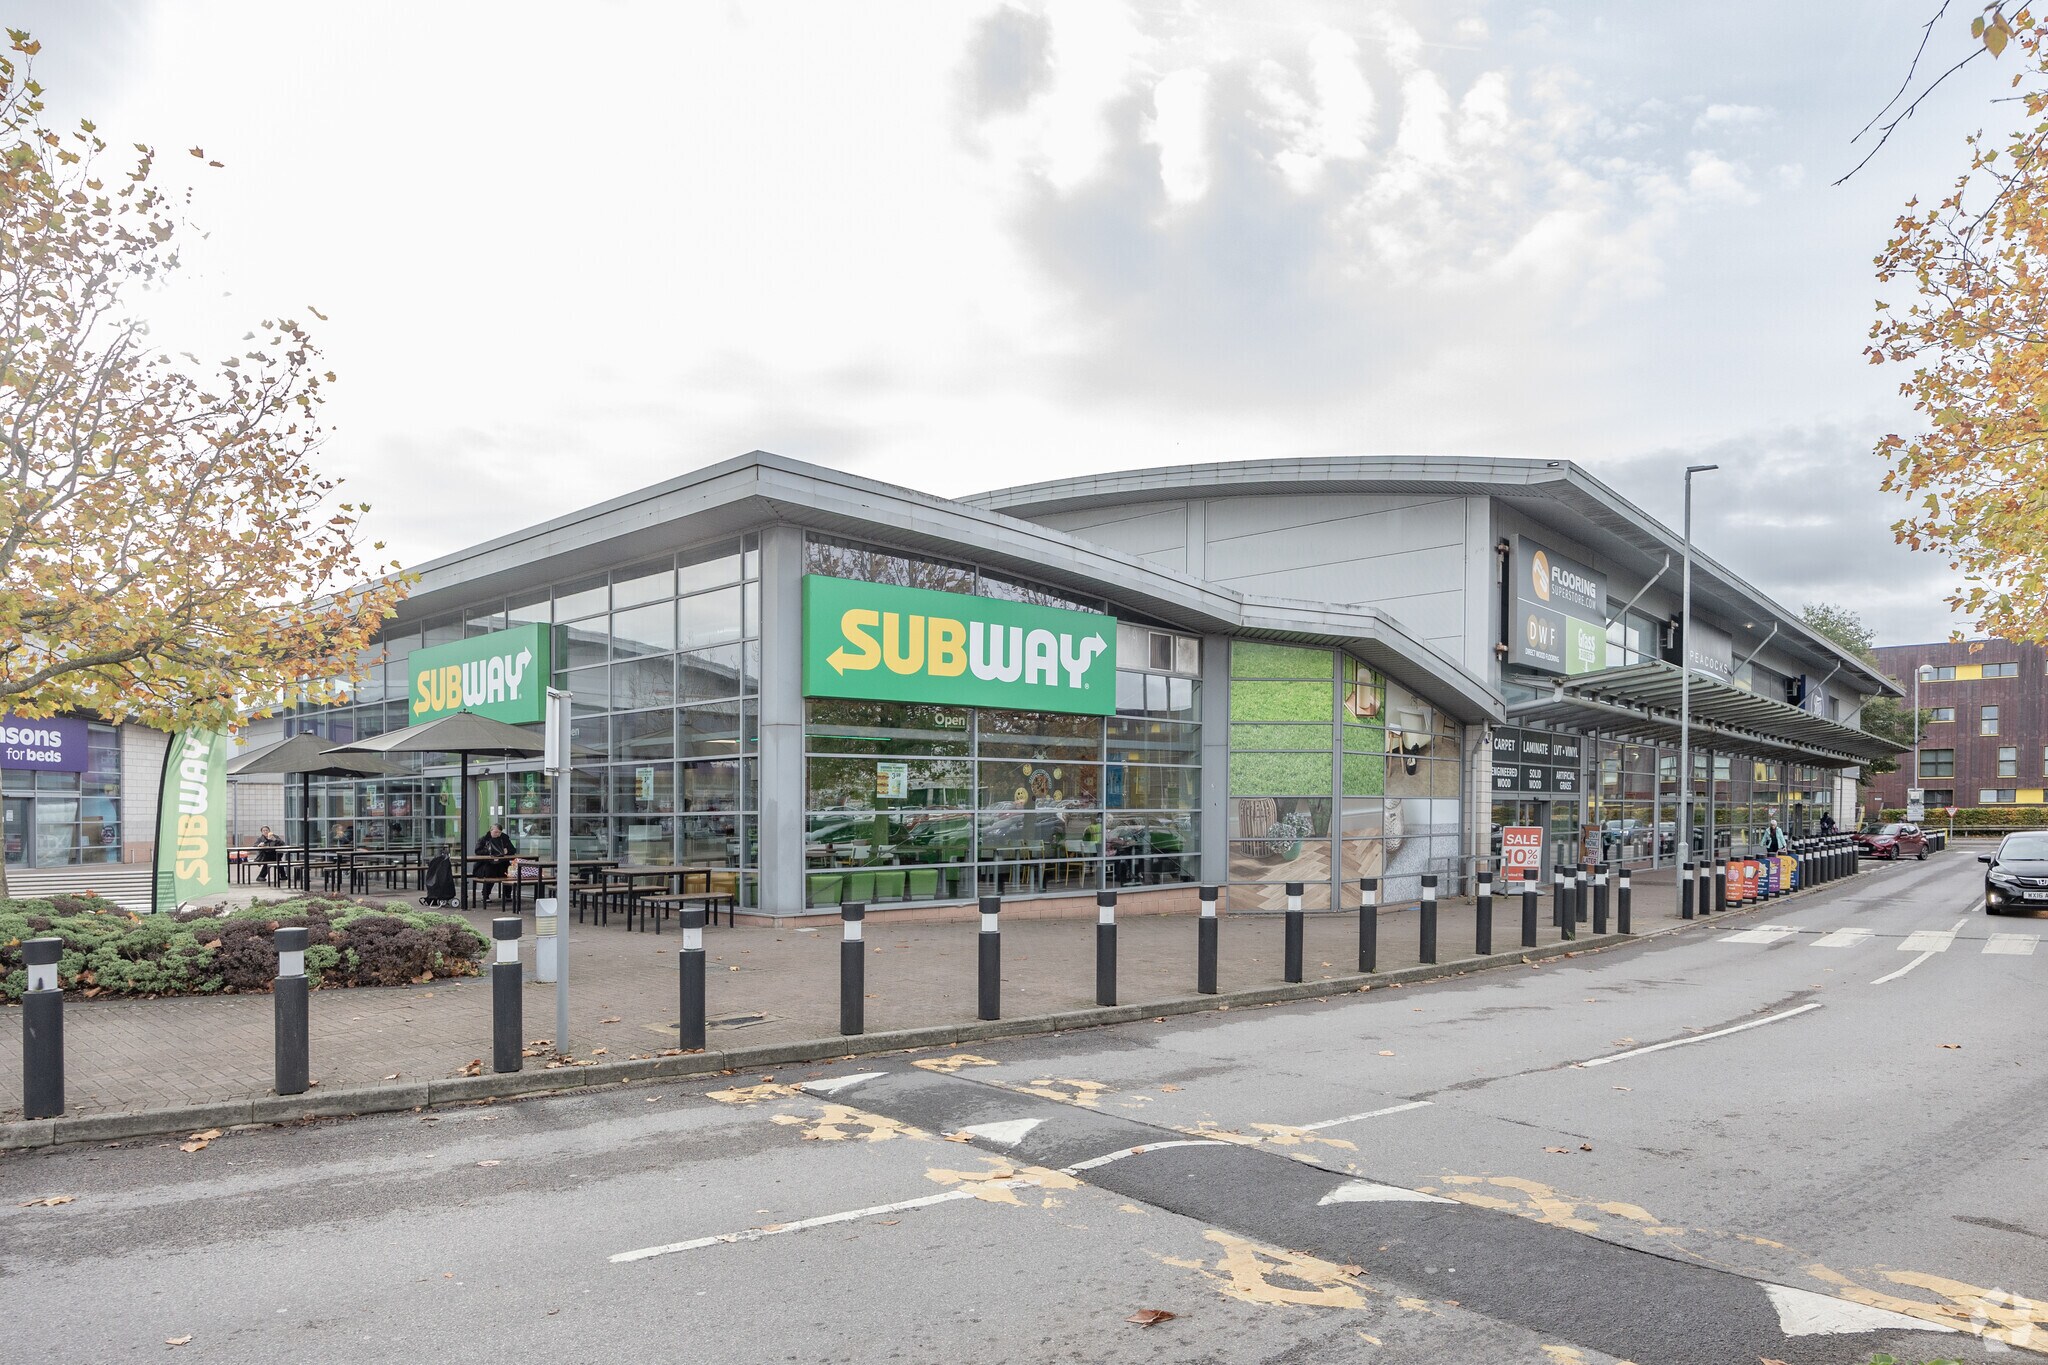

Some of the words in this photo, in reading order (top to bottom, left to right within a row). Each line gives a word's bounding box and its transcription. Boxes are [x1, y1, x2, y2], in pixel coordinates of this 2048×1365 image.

[1552, 566, 1596, 598] FLOORING
[1552, 584, 1596, 610] SUPERSTORE.COM
[826, 609, 1107, 689] SUBWAY
[1690, 650, 1728, 674] PEACOCKS
[413, 646, 532, 717] SUBWAY
[935, 713, 966, 728] Open
[1494, 738, 1516, 751] CARPET
[1523, 741, 1548, 755] LAMINATE
[1554, 745, 1562, 756] LVT
[6, 747, 25, 760] for
[26, 748, 62, 763] beds
[1492, 767, 1518, 777] ENGINEERED
[1529, 769, 1542, 778] SOLID
[1556, 771, 1575, 780] ARTIFICIAL
[1497, 779, 1511, 788] WOOD
[1529, 780, 1542, 789] WOOD
[1560, 781, 1572, 790] GRASS
[176, 728, 212, 886] SUBWAY
[1506, 834, 1539, 844] SALE
[1505, 849, 1538, 864] 10%
